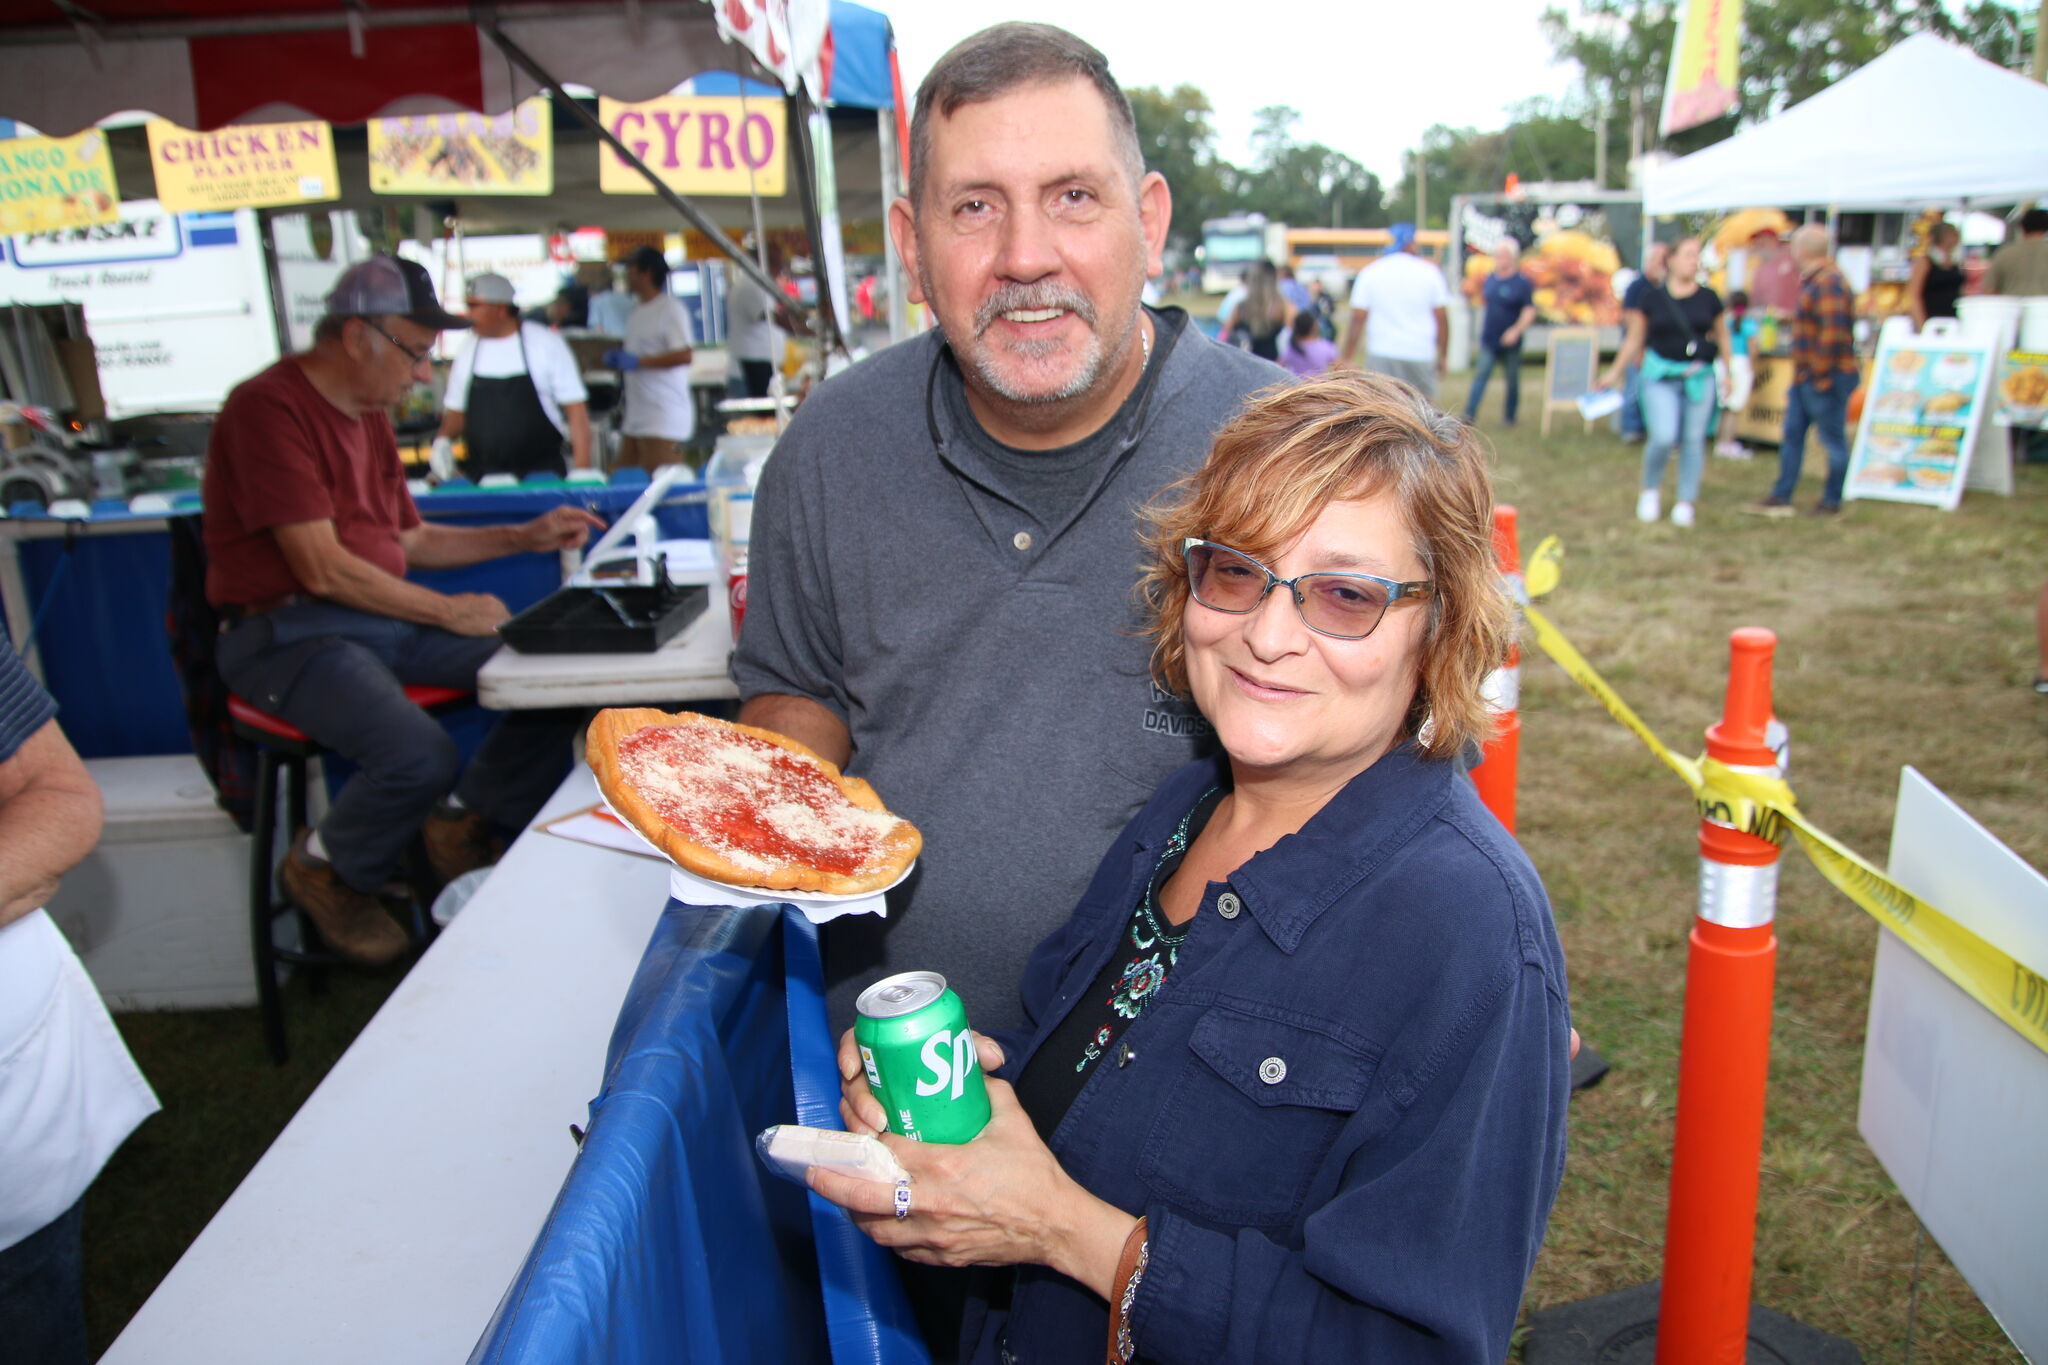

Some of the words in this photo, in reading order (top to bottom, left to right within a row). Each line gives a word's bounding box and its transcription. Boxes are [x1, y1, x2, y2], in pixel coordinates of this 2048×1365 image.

[161, 123, 321, 164] CHICKEN
[611, 110, 775, 171] GYRO
[0, 166, 105, 202] ONADE
[1143, 709, 1218, 736] DAVIDS
[915, 1029, 978, 1101] Sp
[899, 1109, 915, 1131] ME
